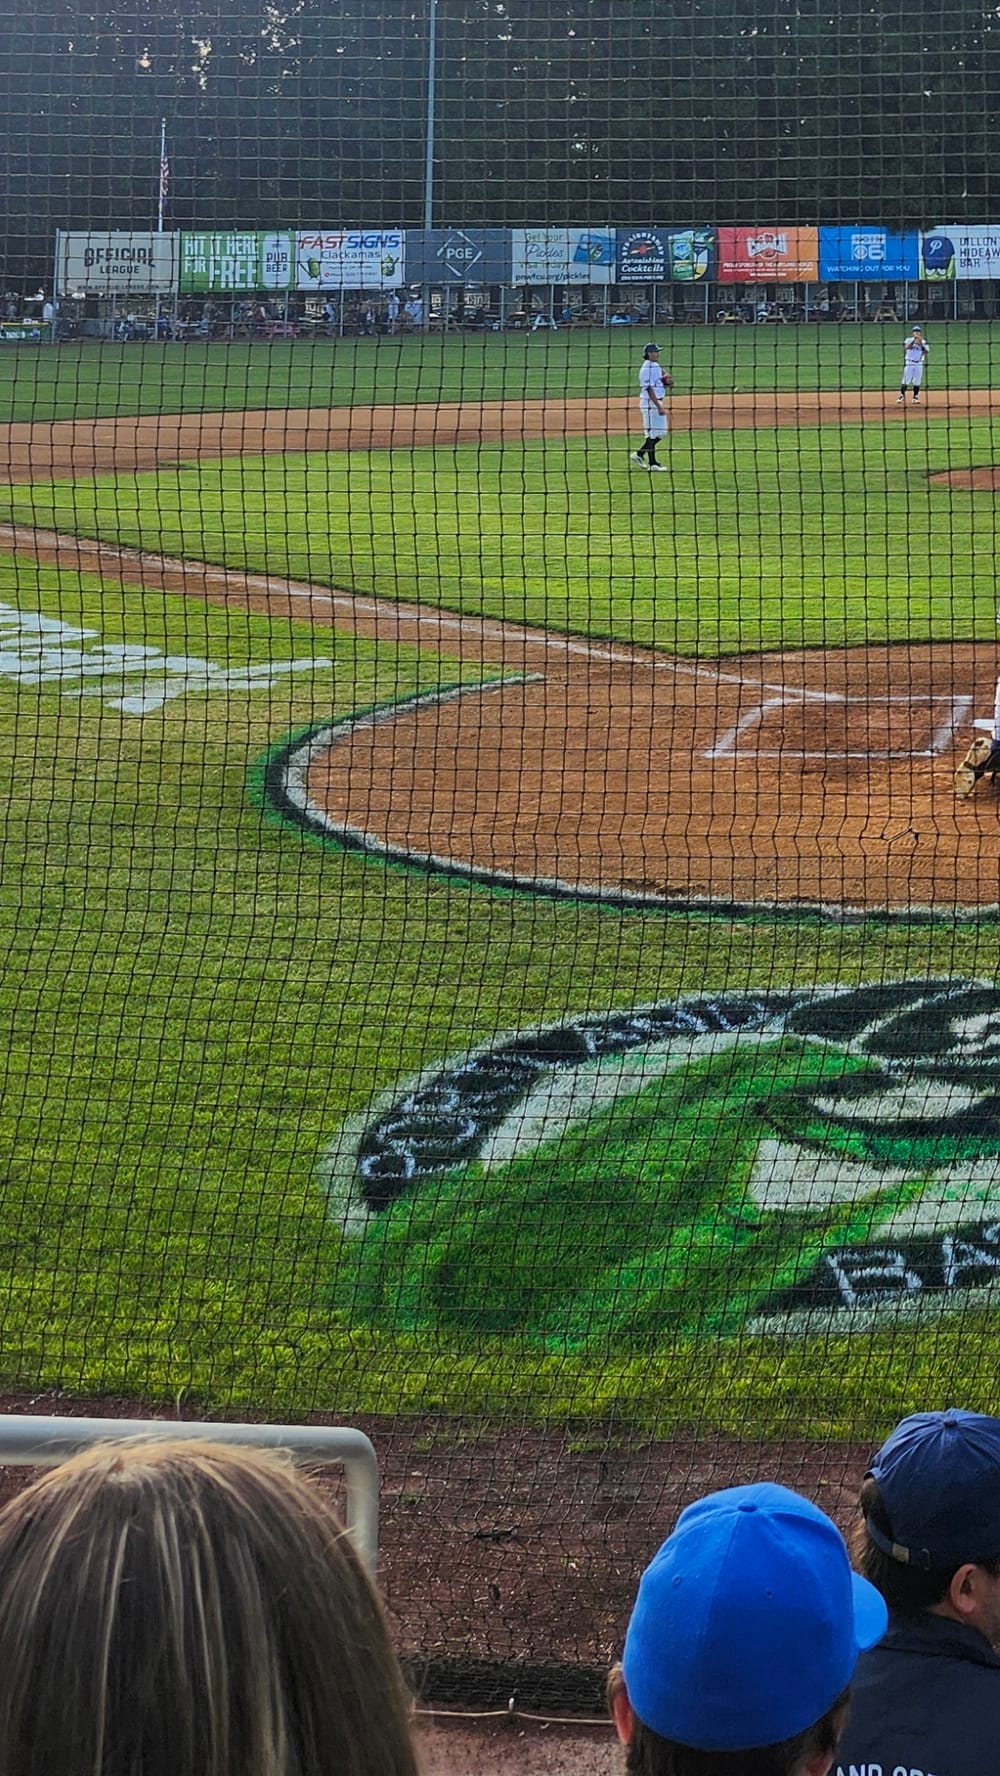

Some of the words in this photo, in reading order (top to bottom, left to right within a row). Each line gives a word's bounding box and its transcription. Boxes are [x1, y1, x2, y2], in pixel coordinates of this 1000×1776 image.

[184, 235, 205, 255] HIT
[209, 235, 221, 255] IT
[226, 234, 259, 255] HERE
[300, 234, 401, 250] FASTSIGNS
[84, 247, 156, 268] OFFICIAL
[266, 252, 288, 262] PUB
[320, 250, 382, 259] Clackamas
[446, 247, 473, 259] PGE
[266, 263, 288, 273] BEER
[621, 264, 665, 273] Cocktails
[959, 259, 981, 268] BAR
[100, 265, 140, 274] LEAGUE
[184, 257, 207, 273] FOR
[208, 255, 259, 289] FREE
